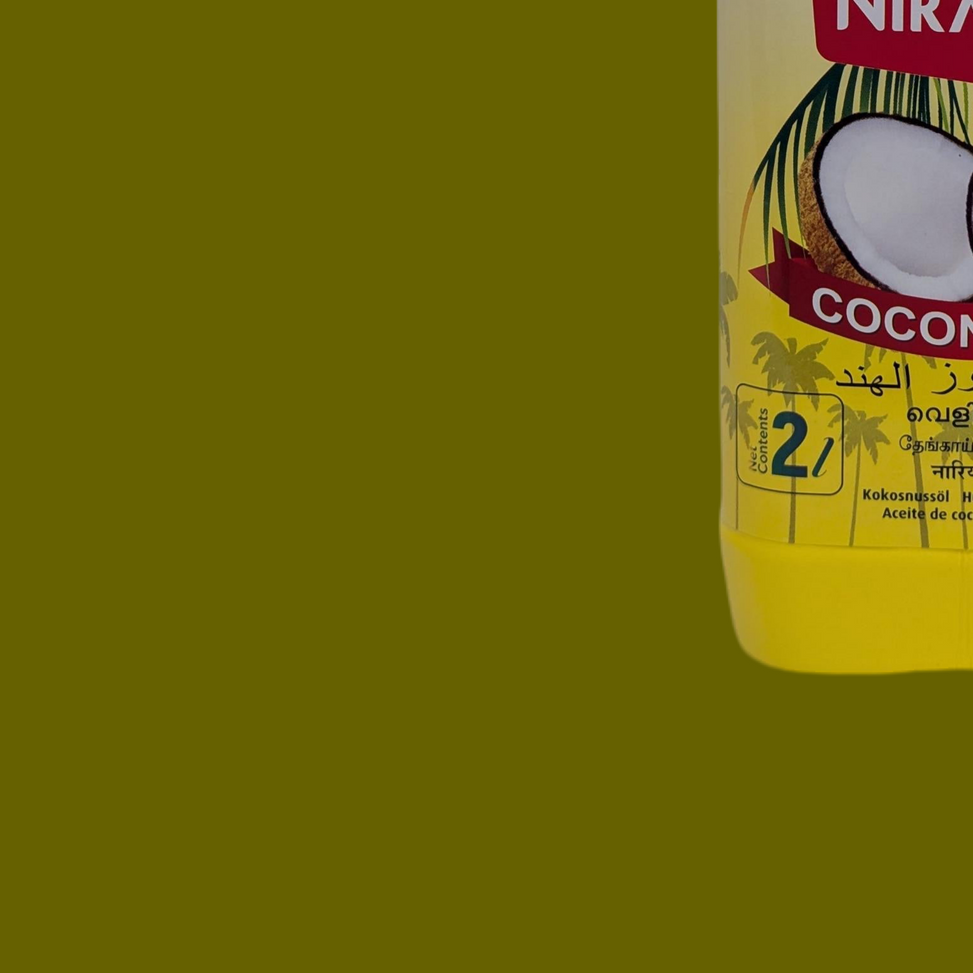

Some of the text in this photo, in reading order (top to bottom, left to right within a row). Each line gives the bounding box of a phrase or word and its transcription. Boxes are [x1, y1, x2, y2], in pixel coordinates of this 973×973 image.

[836, 361, 910, 396] الهند
[758, 408, 768, 474] Contents
[899, 434, 973, 455] தேங்காய்
[749, 446, 757, 472] Net
[862, 489, 949, 502] Kokosnussöl
[882, 507, 925, 520] Aceite
[930, 508, 947, 520] de
